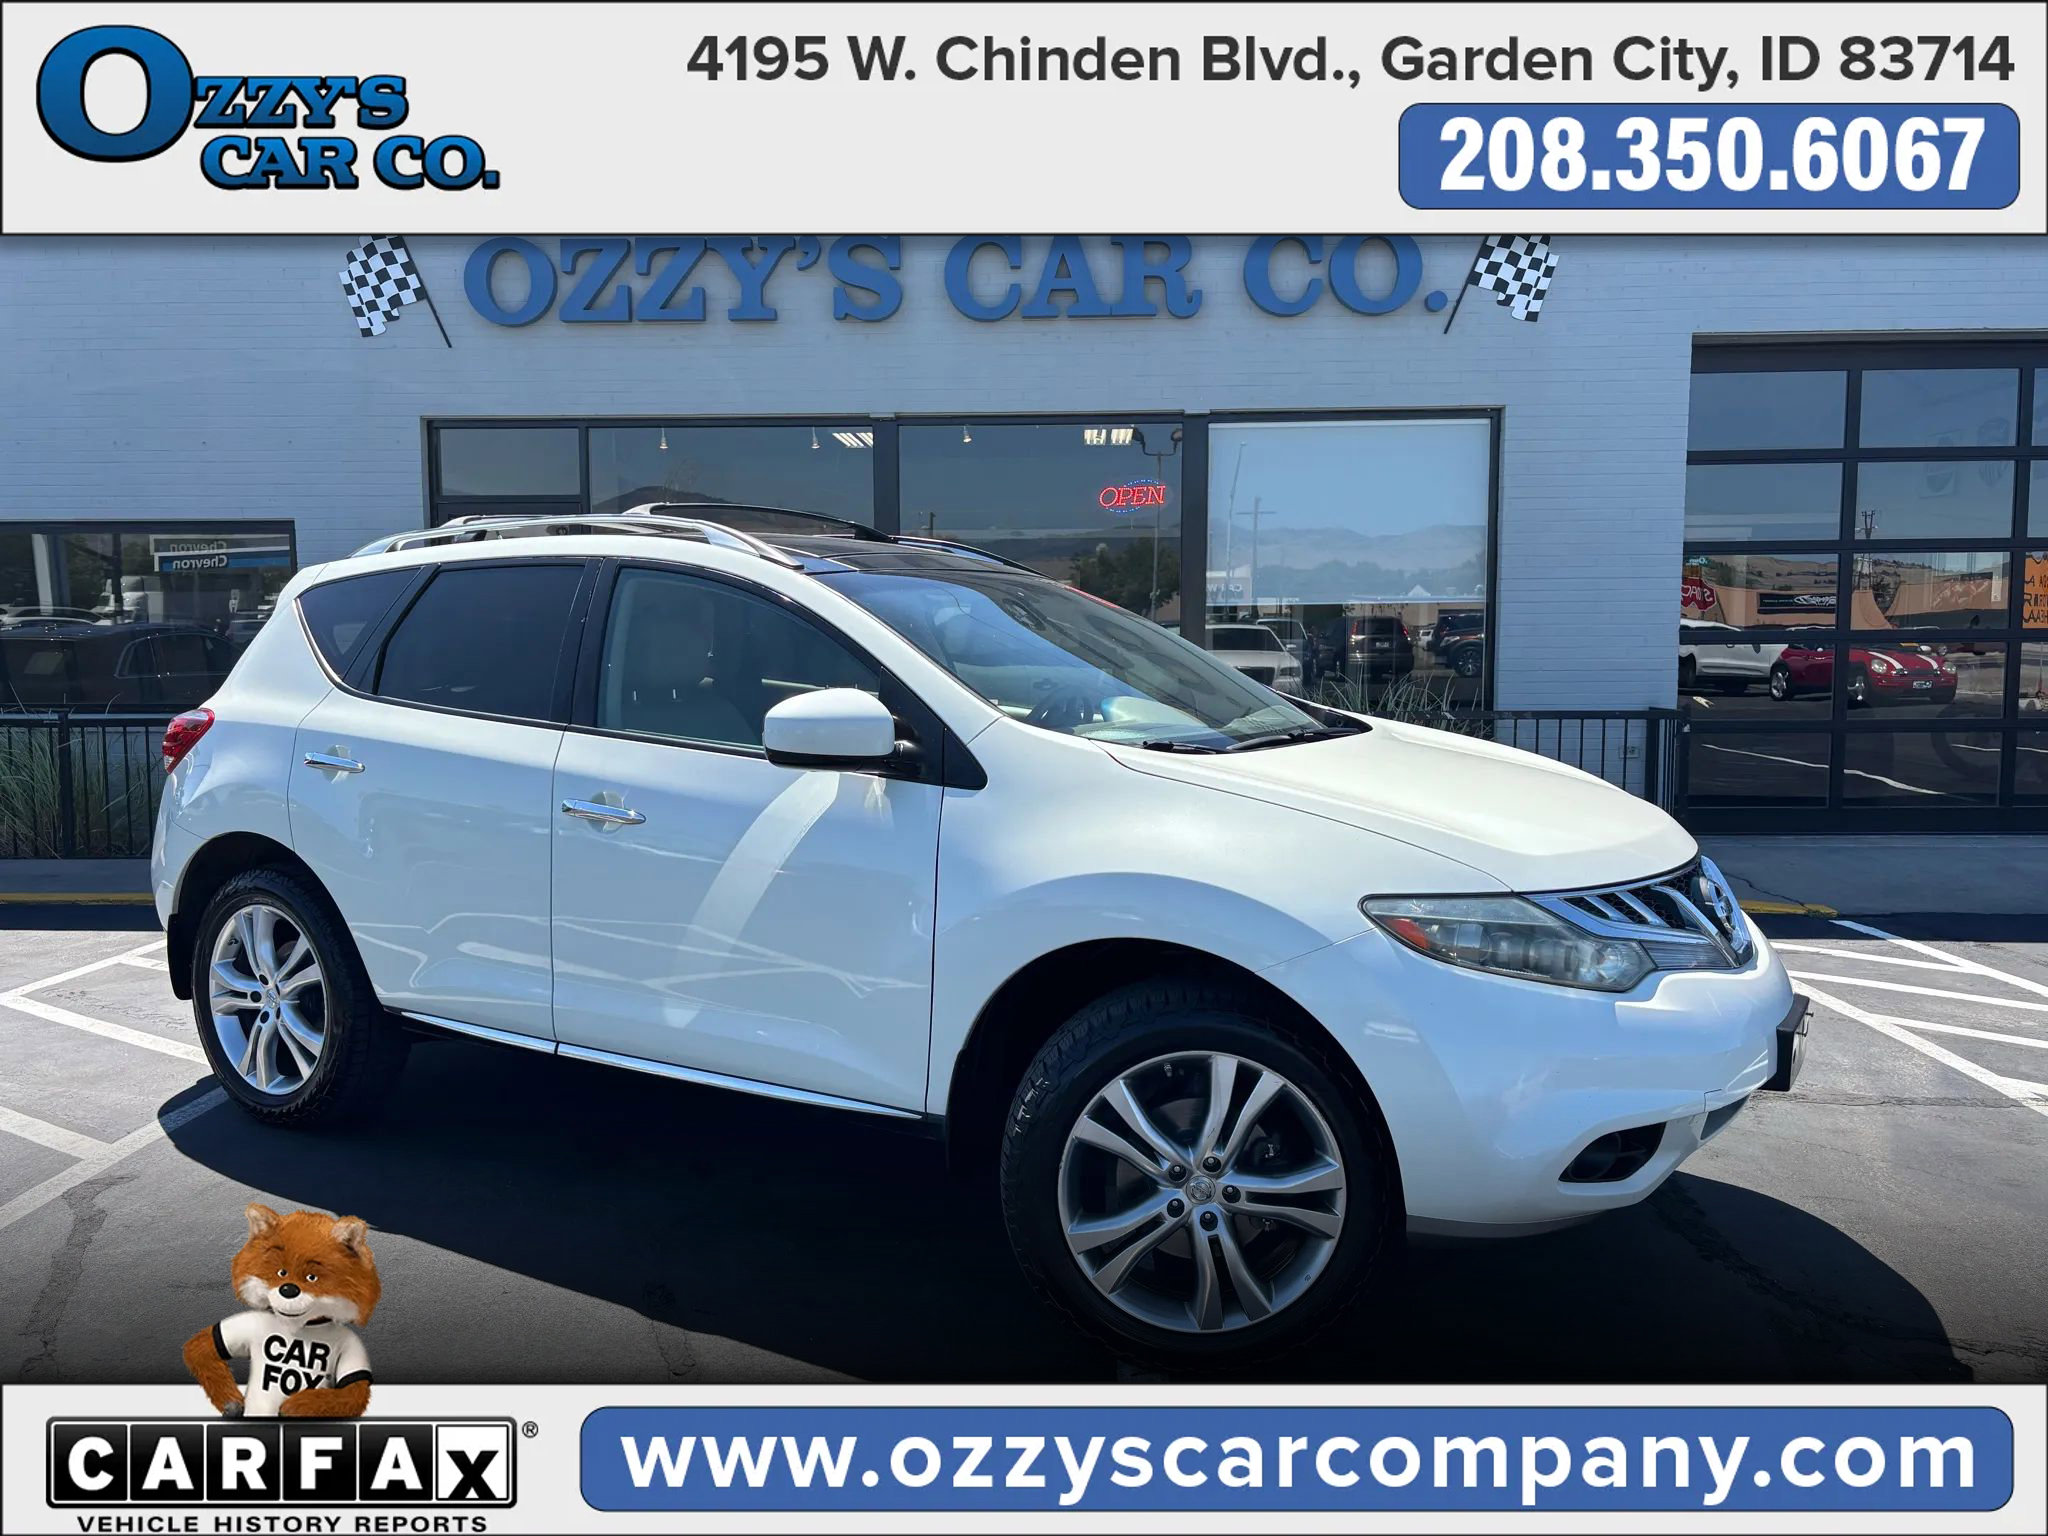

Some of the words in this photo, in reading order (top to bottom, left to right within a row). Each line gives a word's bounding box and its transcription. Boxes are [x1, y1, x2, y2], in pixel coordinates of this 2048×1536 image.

[464, 236, 903, 327] OZZY'S
[944, 236, 1202, 322] CAR
[1243, 236, 1448, 317] CO.
[1099, 485, 1167, 508] OPEN
